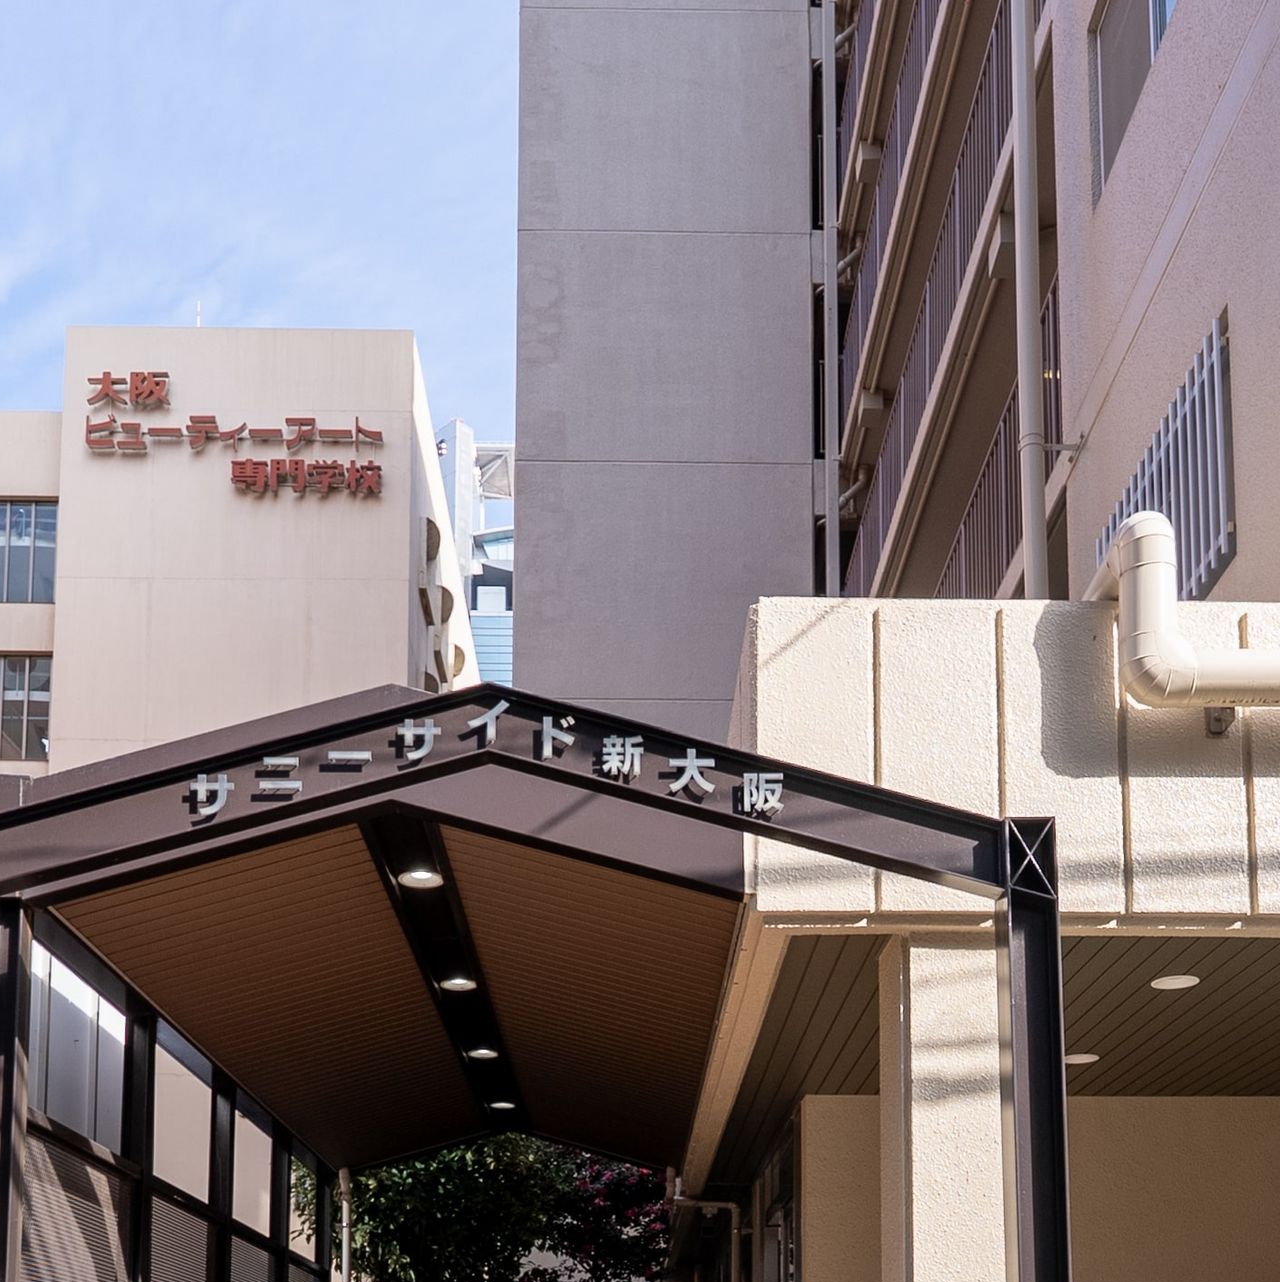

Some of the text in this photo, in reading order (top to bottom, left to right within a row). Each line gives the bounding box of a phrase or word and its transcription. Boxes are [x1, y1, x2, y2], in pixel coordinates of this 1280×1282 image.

[87, 371, 171, 405] 大阪
[85, 415, 384, 451] ビューティーアート
[231, 458, 383, 494] 専門学校
[190, 699, 785, 815] サニーサイド新大阪
